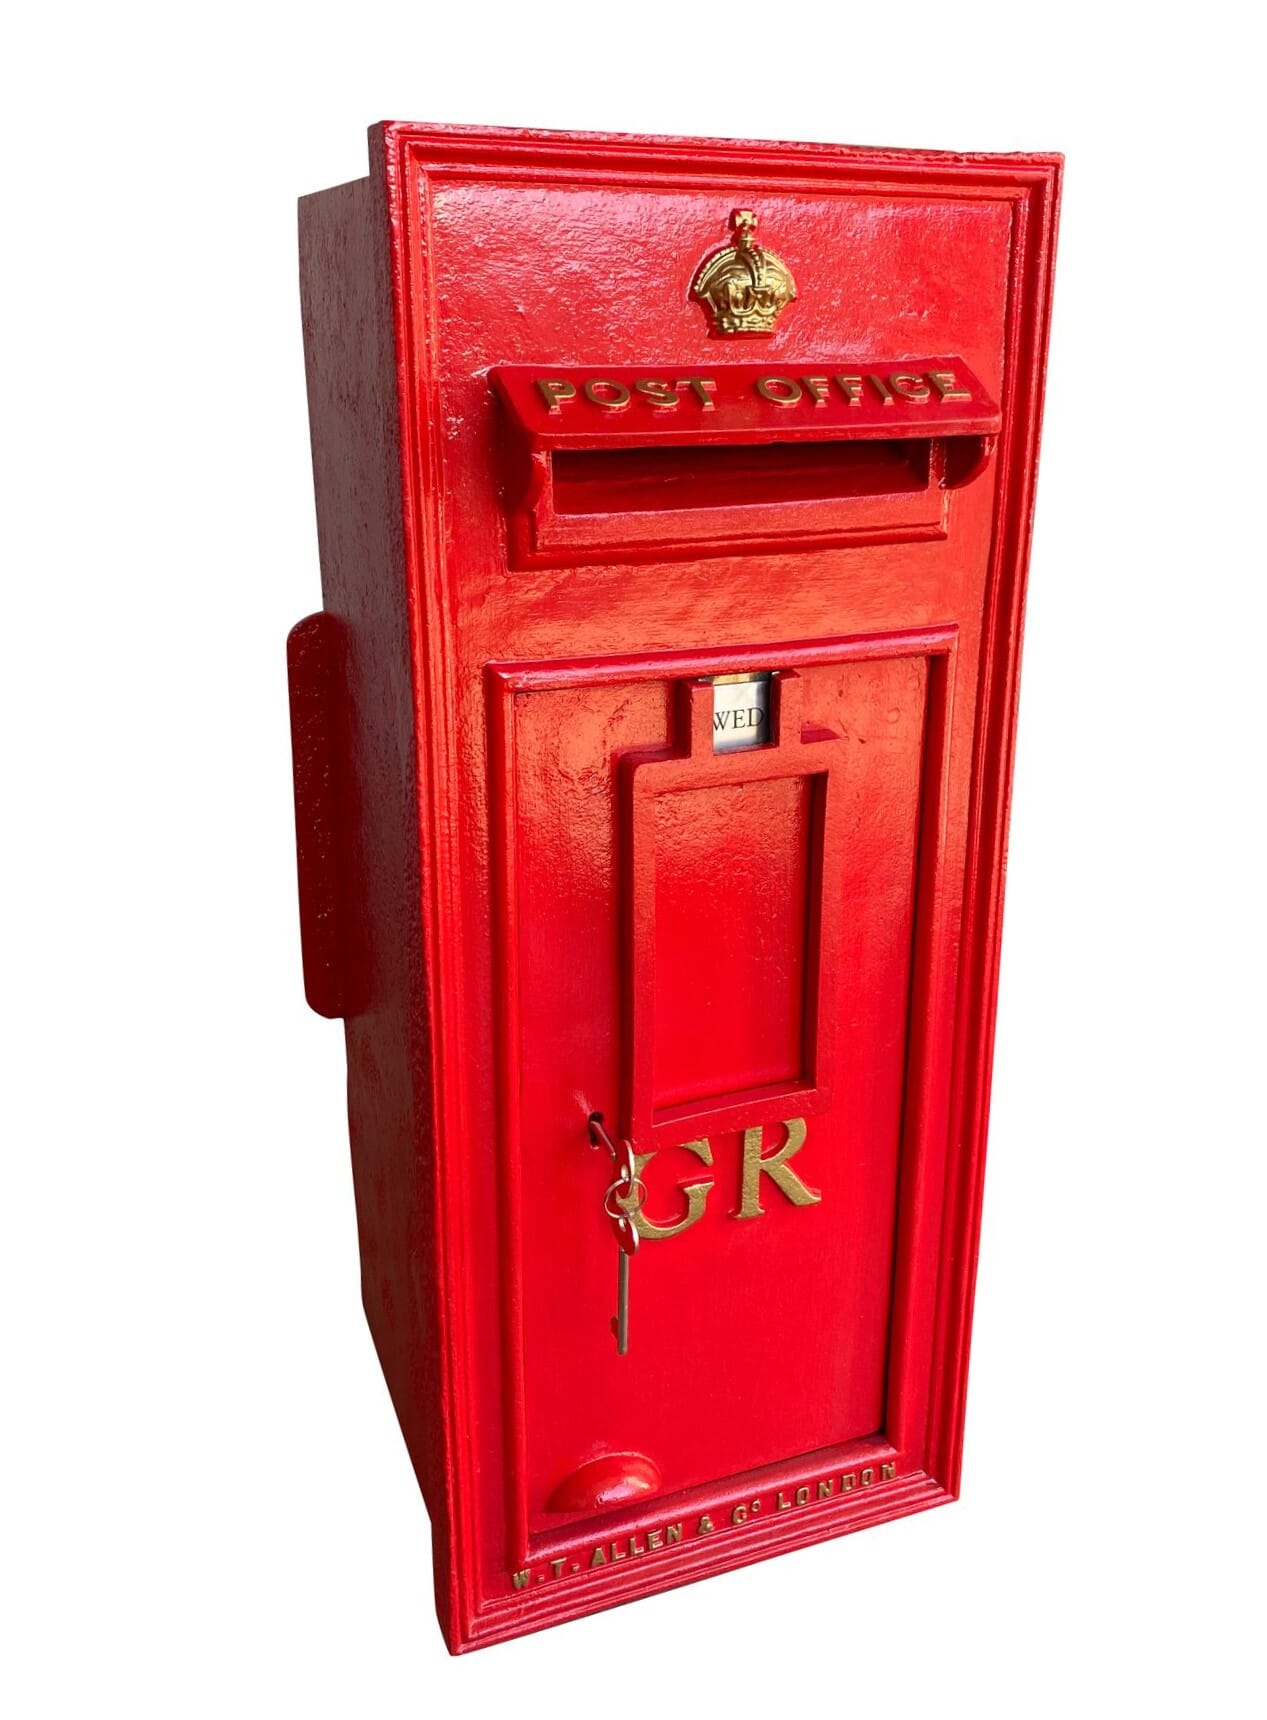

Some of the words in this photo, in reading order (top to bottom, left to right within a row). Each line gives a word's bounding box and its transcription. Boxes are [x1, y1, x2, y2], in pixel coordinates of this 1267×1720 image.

[537, 377, 716, 415] POST
[756, 369, 973, 408] OFFICE
[713, 706, 765, 732] WED
[615, 1116, 822, 1241] GR
[591, 1522, 683, 1568] ALLEN
[698, 1515, 715, 1535] &
[777, 1461, 896, 1511] LONDON
